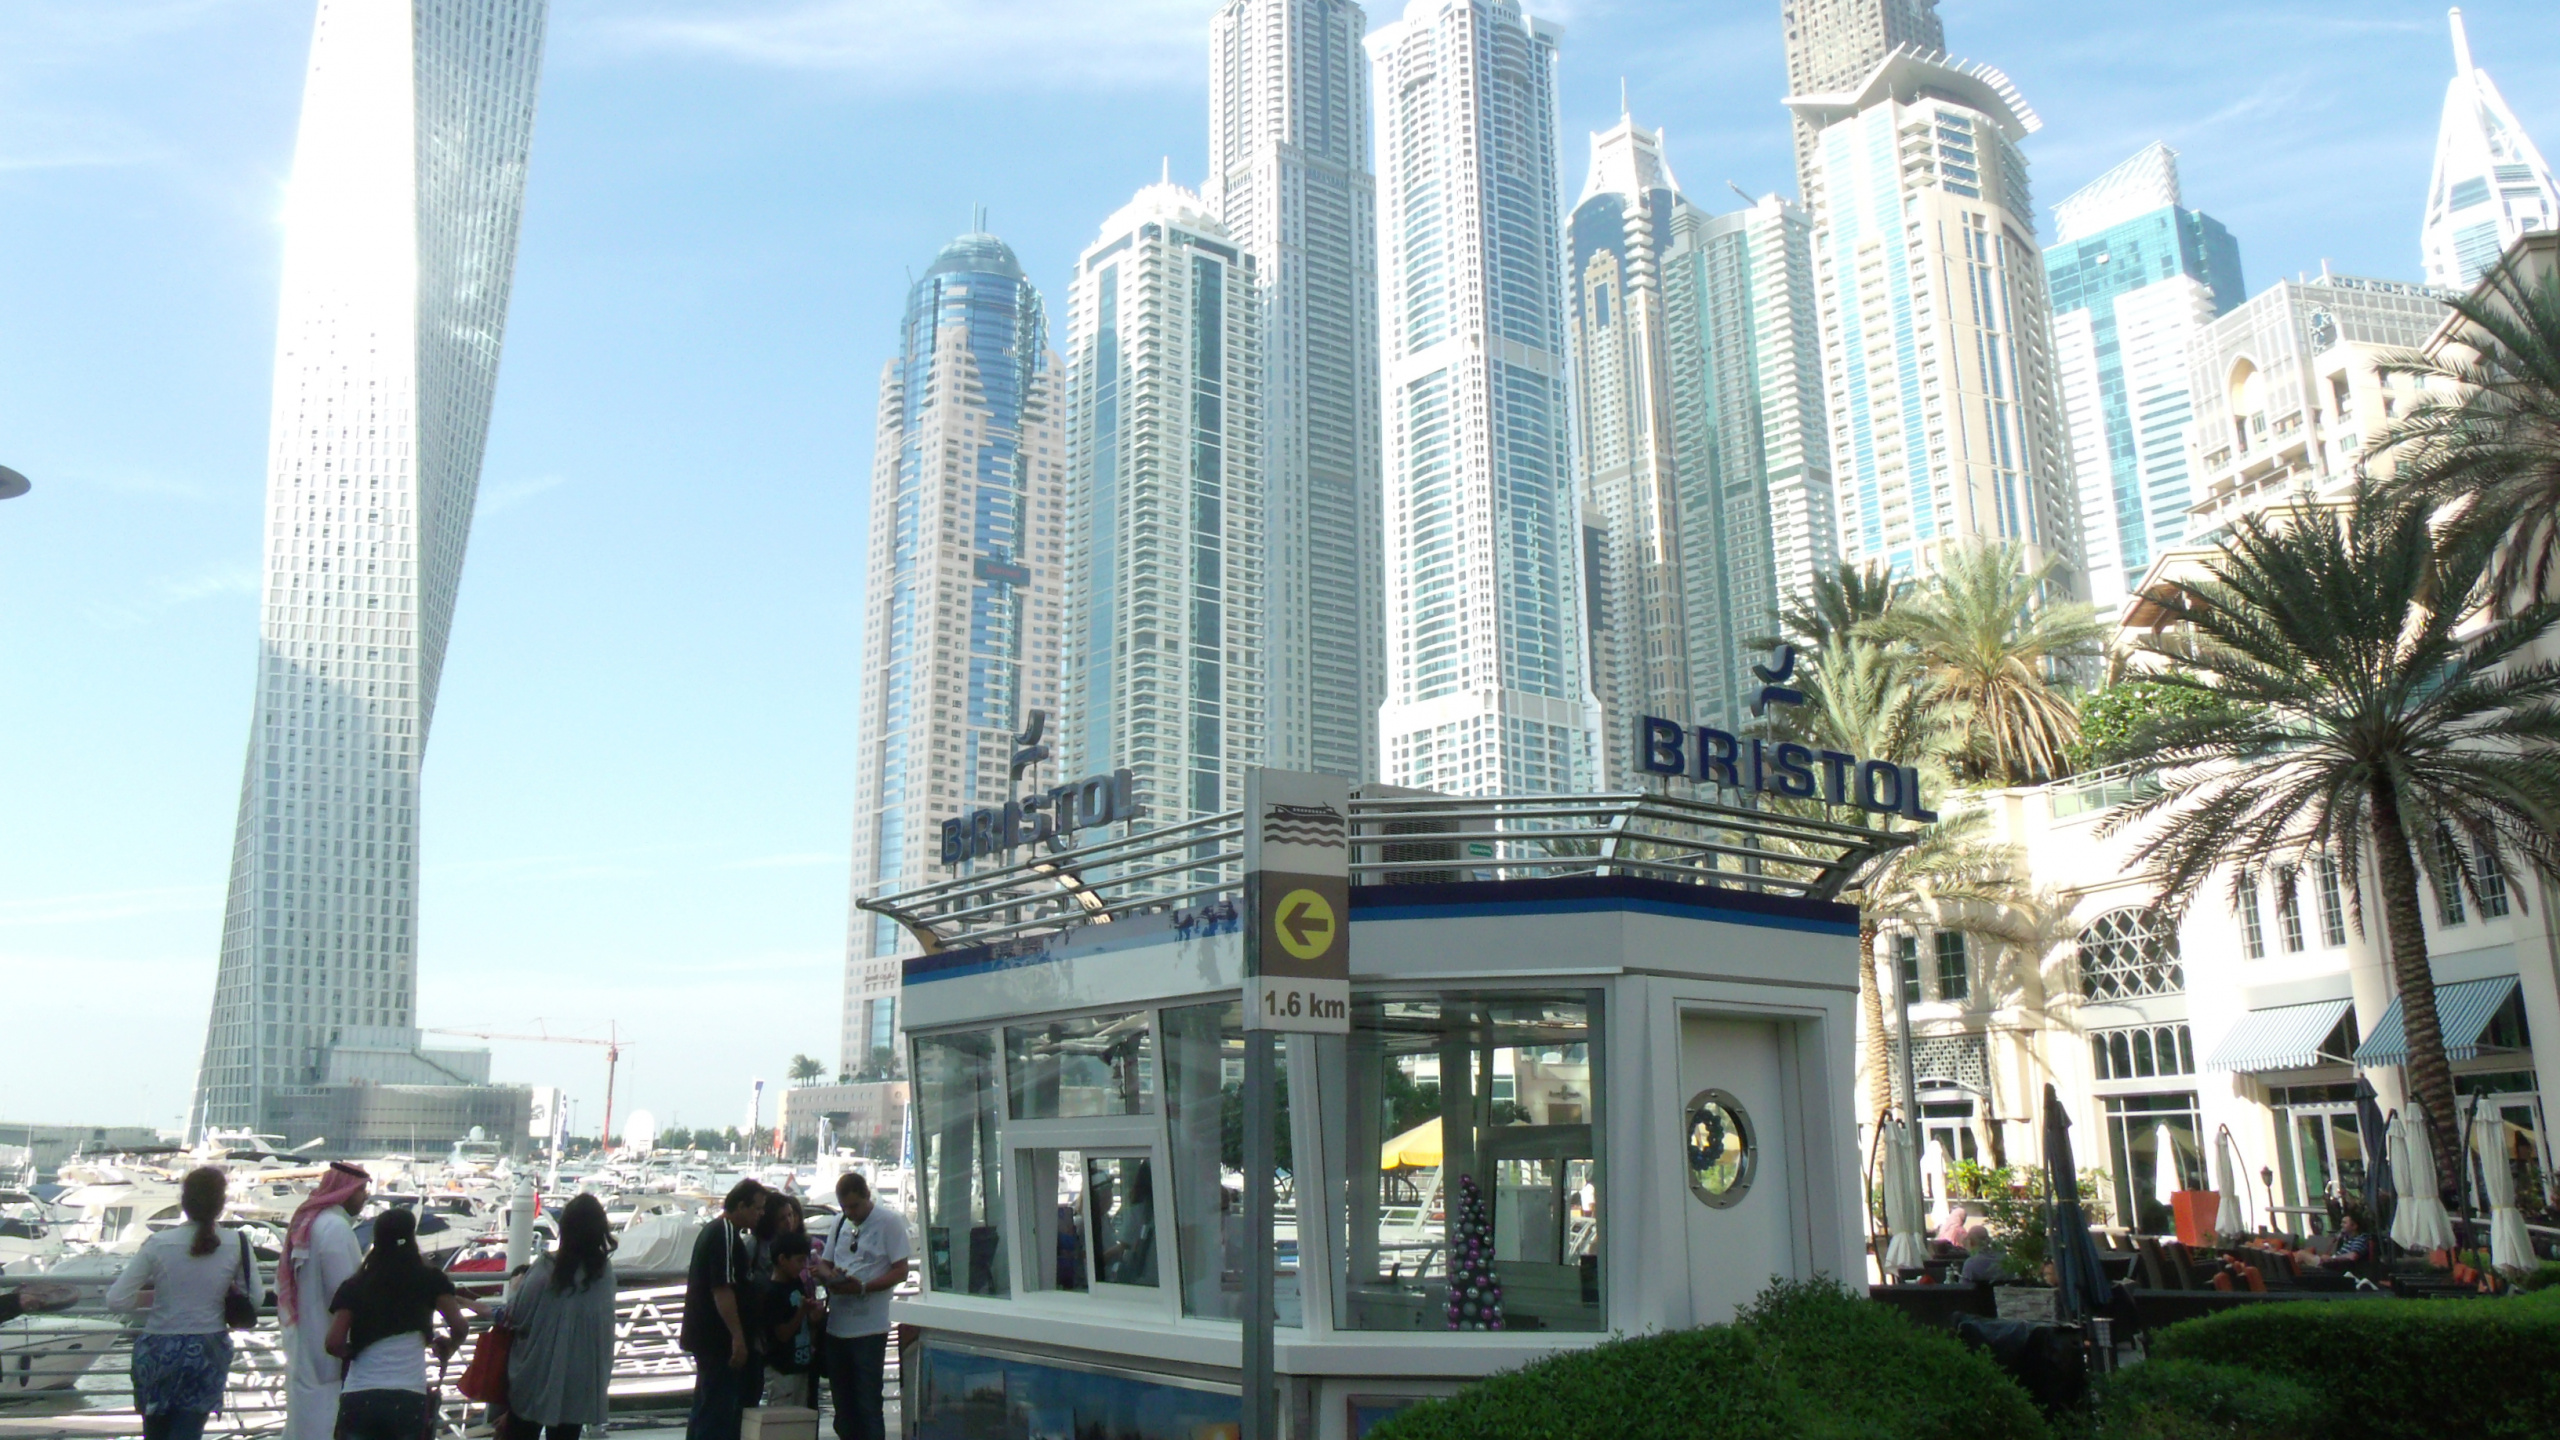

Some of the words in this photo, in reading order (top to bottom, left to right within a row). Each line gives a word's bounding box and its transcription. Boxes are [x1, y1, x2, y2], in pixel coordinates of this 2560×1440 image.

[1633, 714, 1938, 823] BRISTOL
[941, 769, 1146, 865] BRISTOL
[1265, 990, 1301, 1017] 1.6
[1309, 992, 1345, 1018] km
